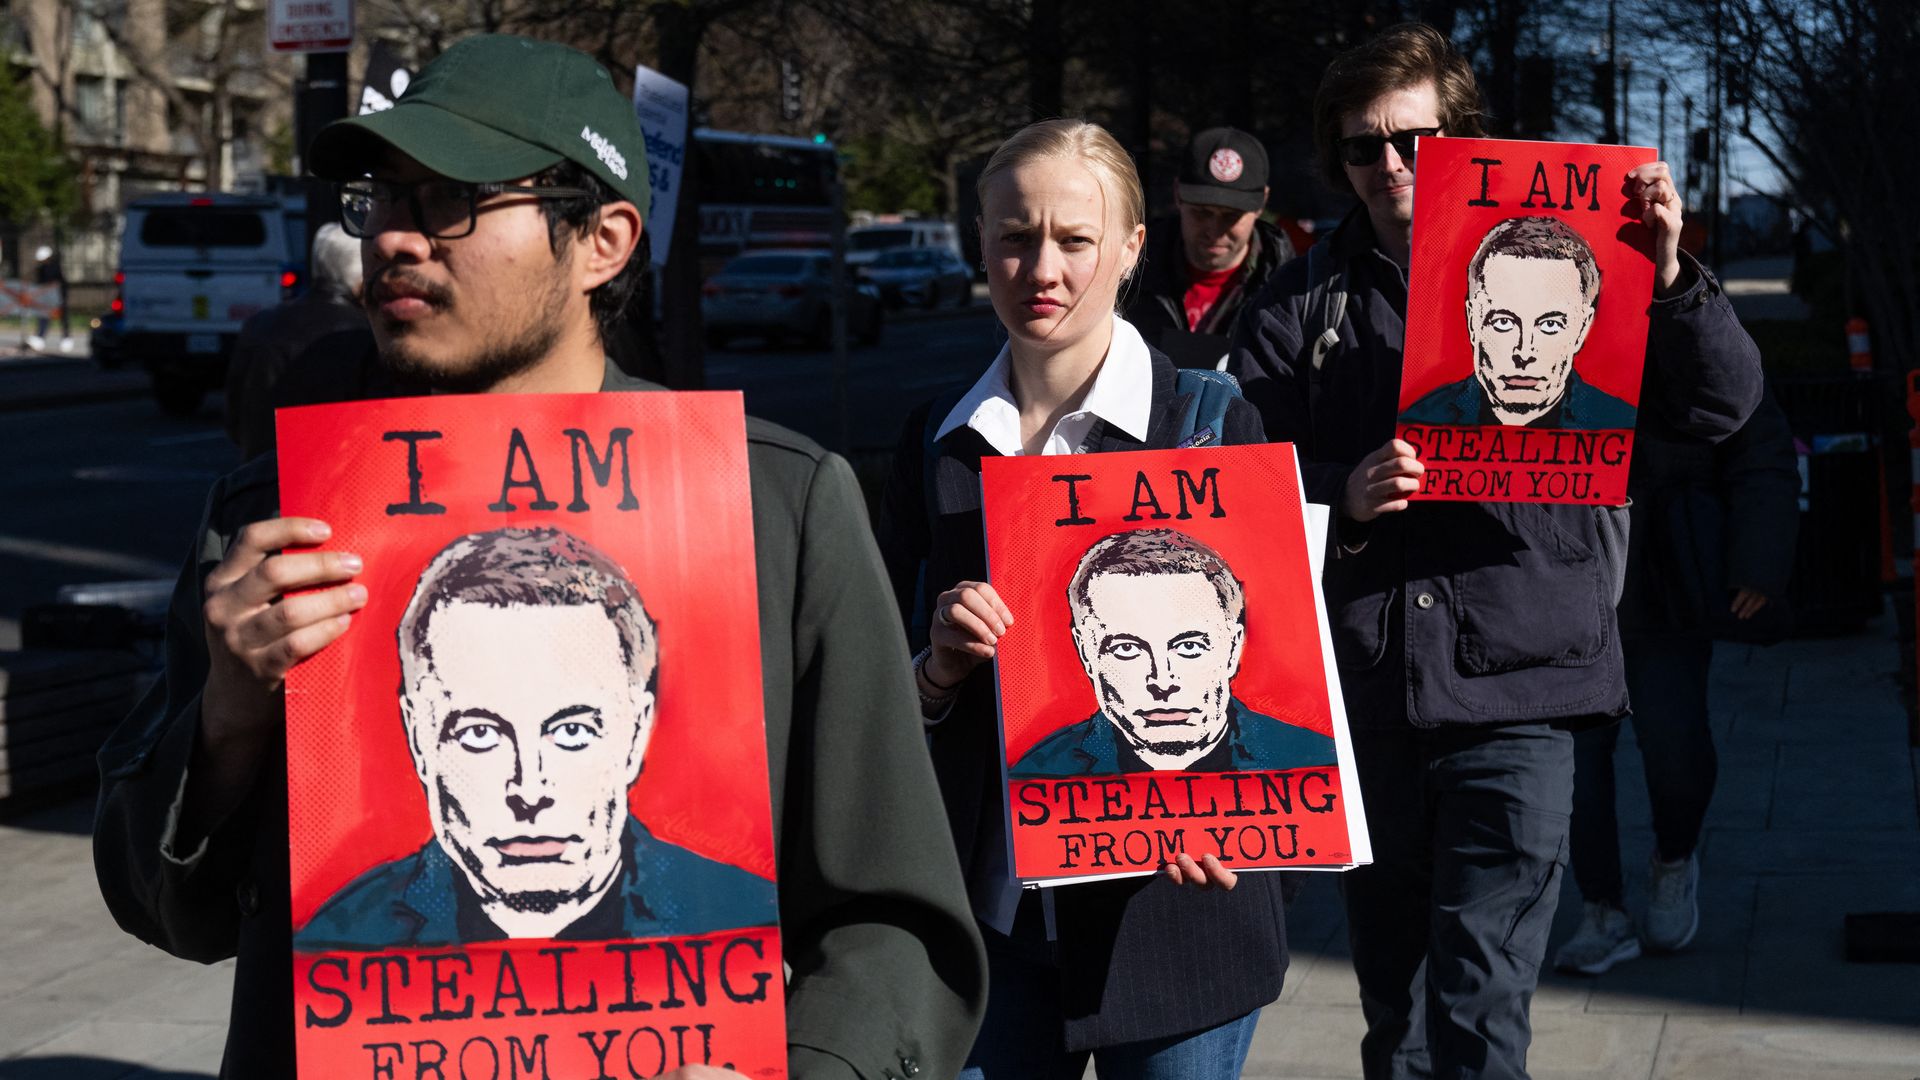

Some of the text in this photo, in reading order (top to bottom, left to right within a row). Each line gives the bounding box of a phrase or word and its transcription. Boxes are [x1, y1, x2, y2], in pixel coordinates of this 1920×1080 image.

[1468, 158, 1600, 211] I AM
[383, 427, 640, 515] I AM
[1403, 427, 1626, 466] STEALING
[1051, 467, 1227, 526] I AM
[1420, 468, 1601, 500] FROM YOU.
[1018, 772, 1337, 826] STEALING
[1057, 824, 1316, 868] FROM YOU.
[305, 937, 773, 1028] STEALING
[362, 1024, 736, 1080] FROM YOU.
